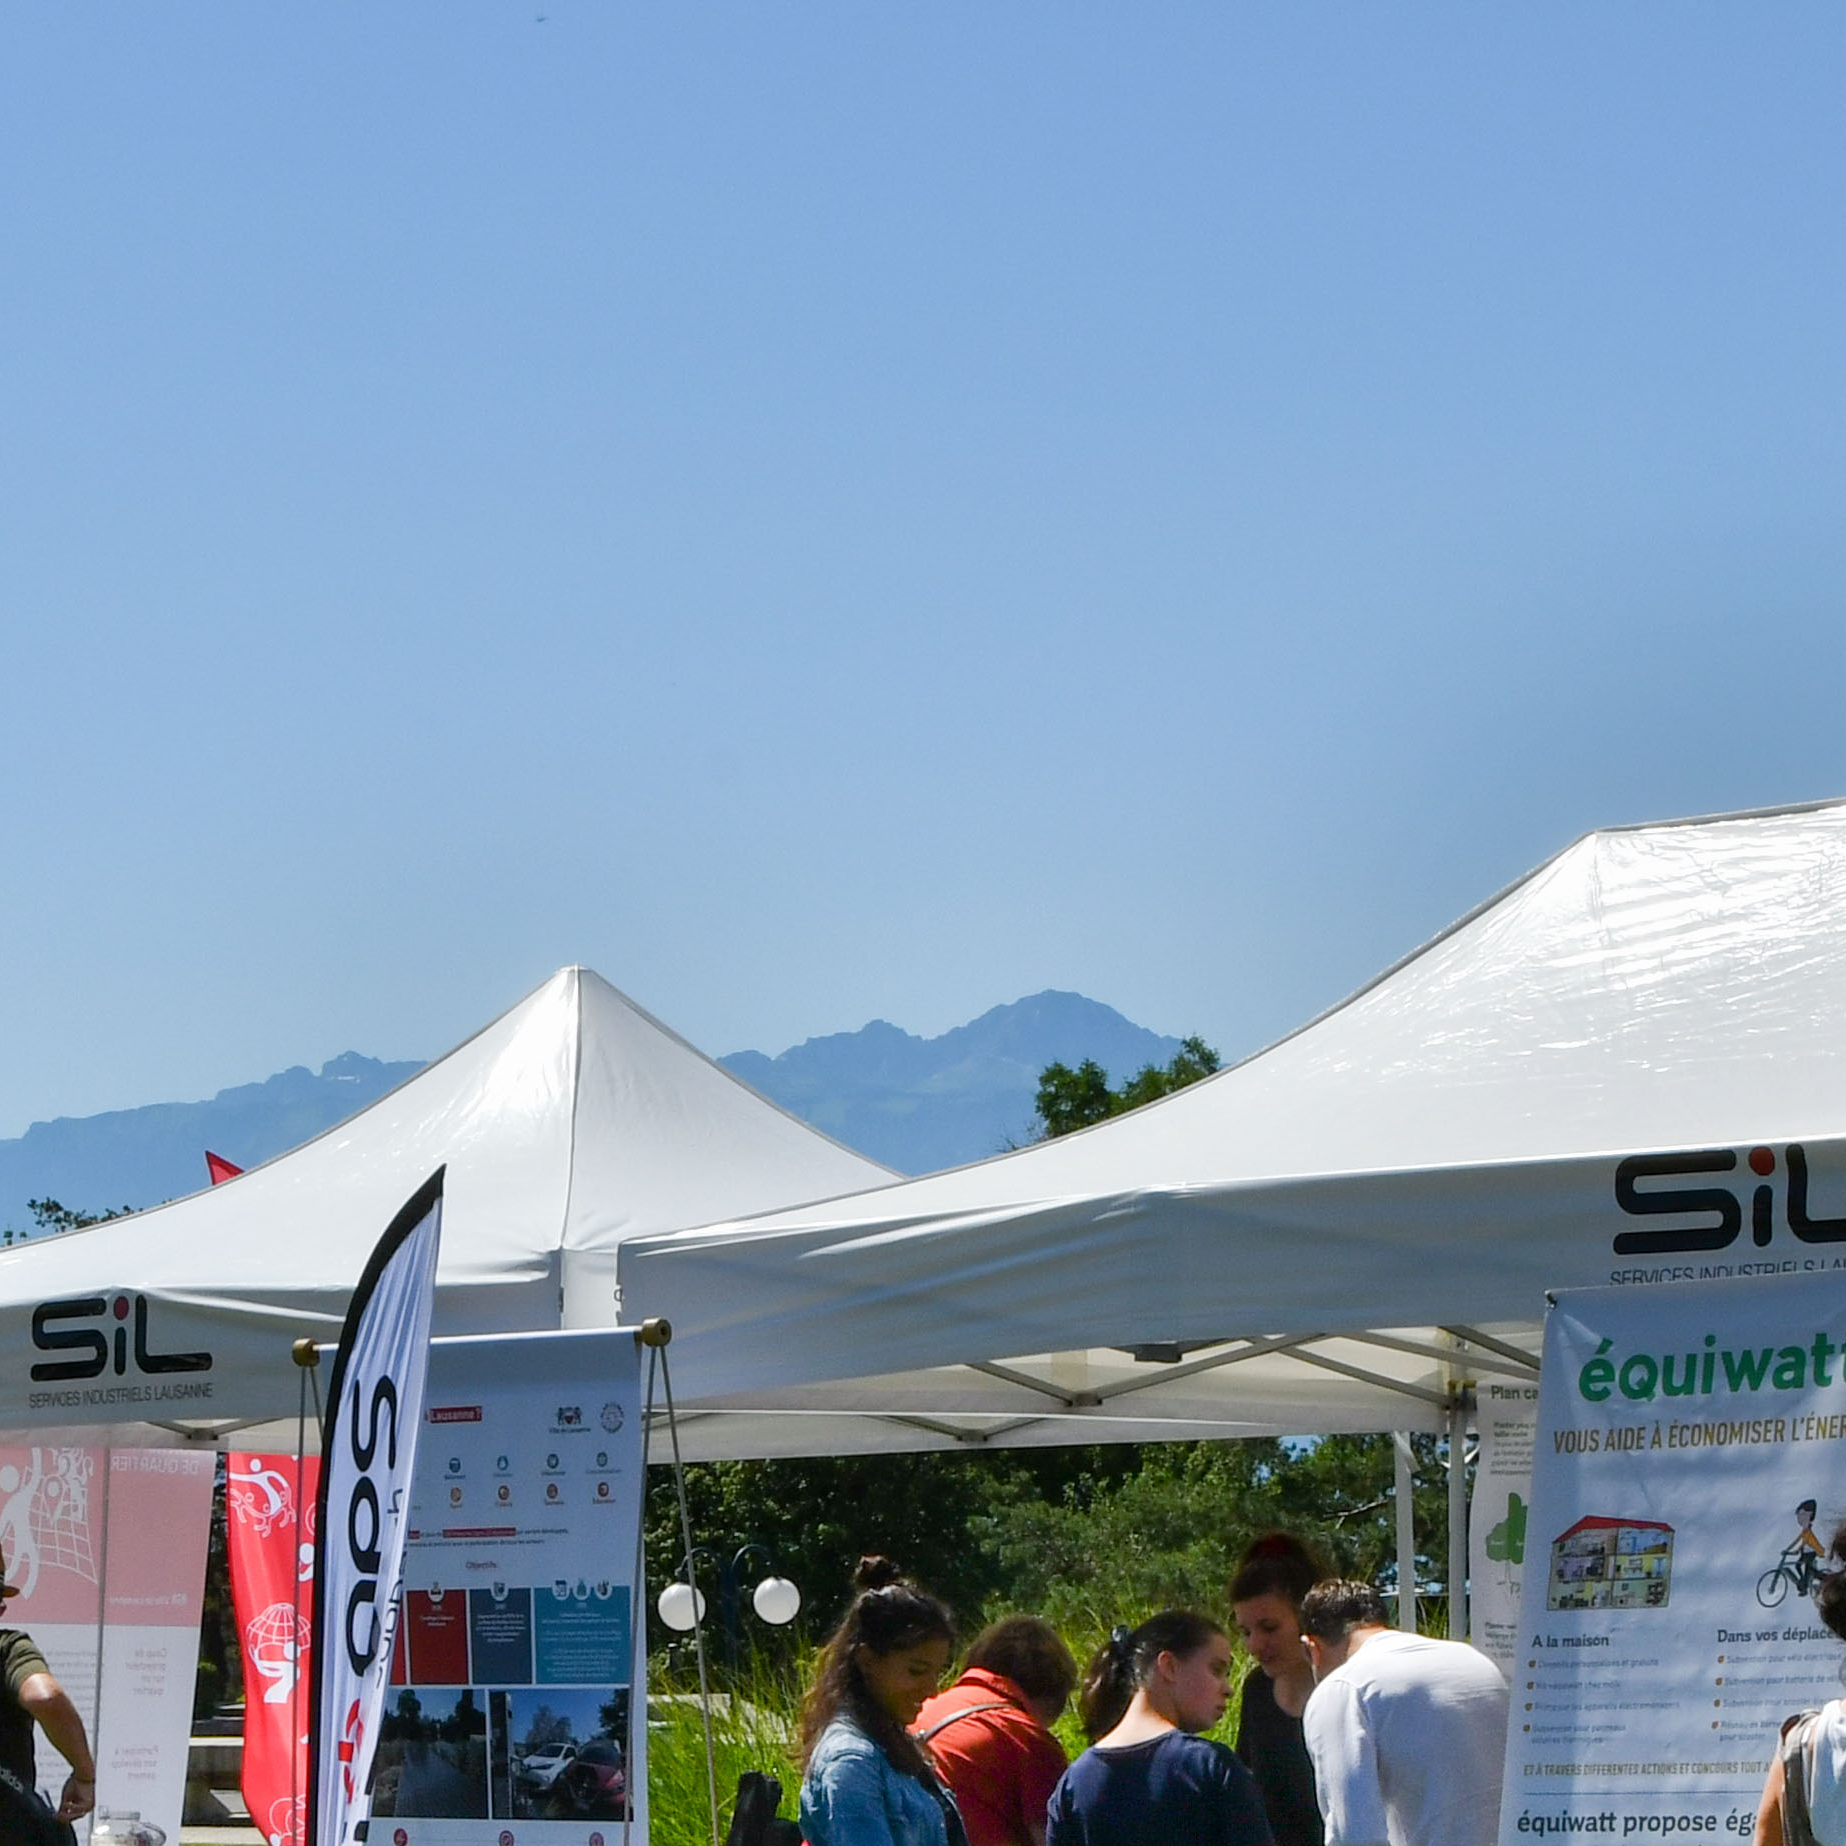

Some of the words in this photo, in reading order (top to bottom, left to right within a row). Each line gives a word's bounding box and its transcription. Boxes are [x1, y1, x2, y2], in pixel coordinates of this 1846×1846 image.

[30, 1391, 80, 1408] SERVICES
[83, 1386, 151, 1404] INDUSTRIELS
[154, 1383, 213, 1400] LAUSANNE
[1491, 1385, 1520, 1399] Plan
[1554, 1430, 1599, 1453] VOUS
[1603, 1426, 1646, 1451] AIDE
[1650, 1420, 1662, 1449] À
[1668, 1418, 1785, 1448] ÉCONOMISER
[1547, 1635, 1558, 1647] la
[1562, 1634, 1610, 1647] maison
[1717, 1629, 1751, 1643] Dans
[1756, 1631, 1778, 1641] vos
[1544, 1764, 1582, 1776] TRAVERS
[1642, 1763, 1677, 1774] ACTIONS
[1679, 1763, 1690, 1774] ET
[1691, 1762, 1738, 1774] CONCOURS
[1741, 1762, 1761, 1773] TOUT
[1517, 1810, 1616, 1837] équiwatt
[1624, 1815, 1716, 1836] propose
